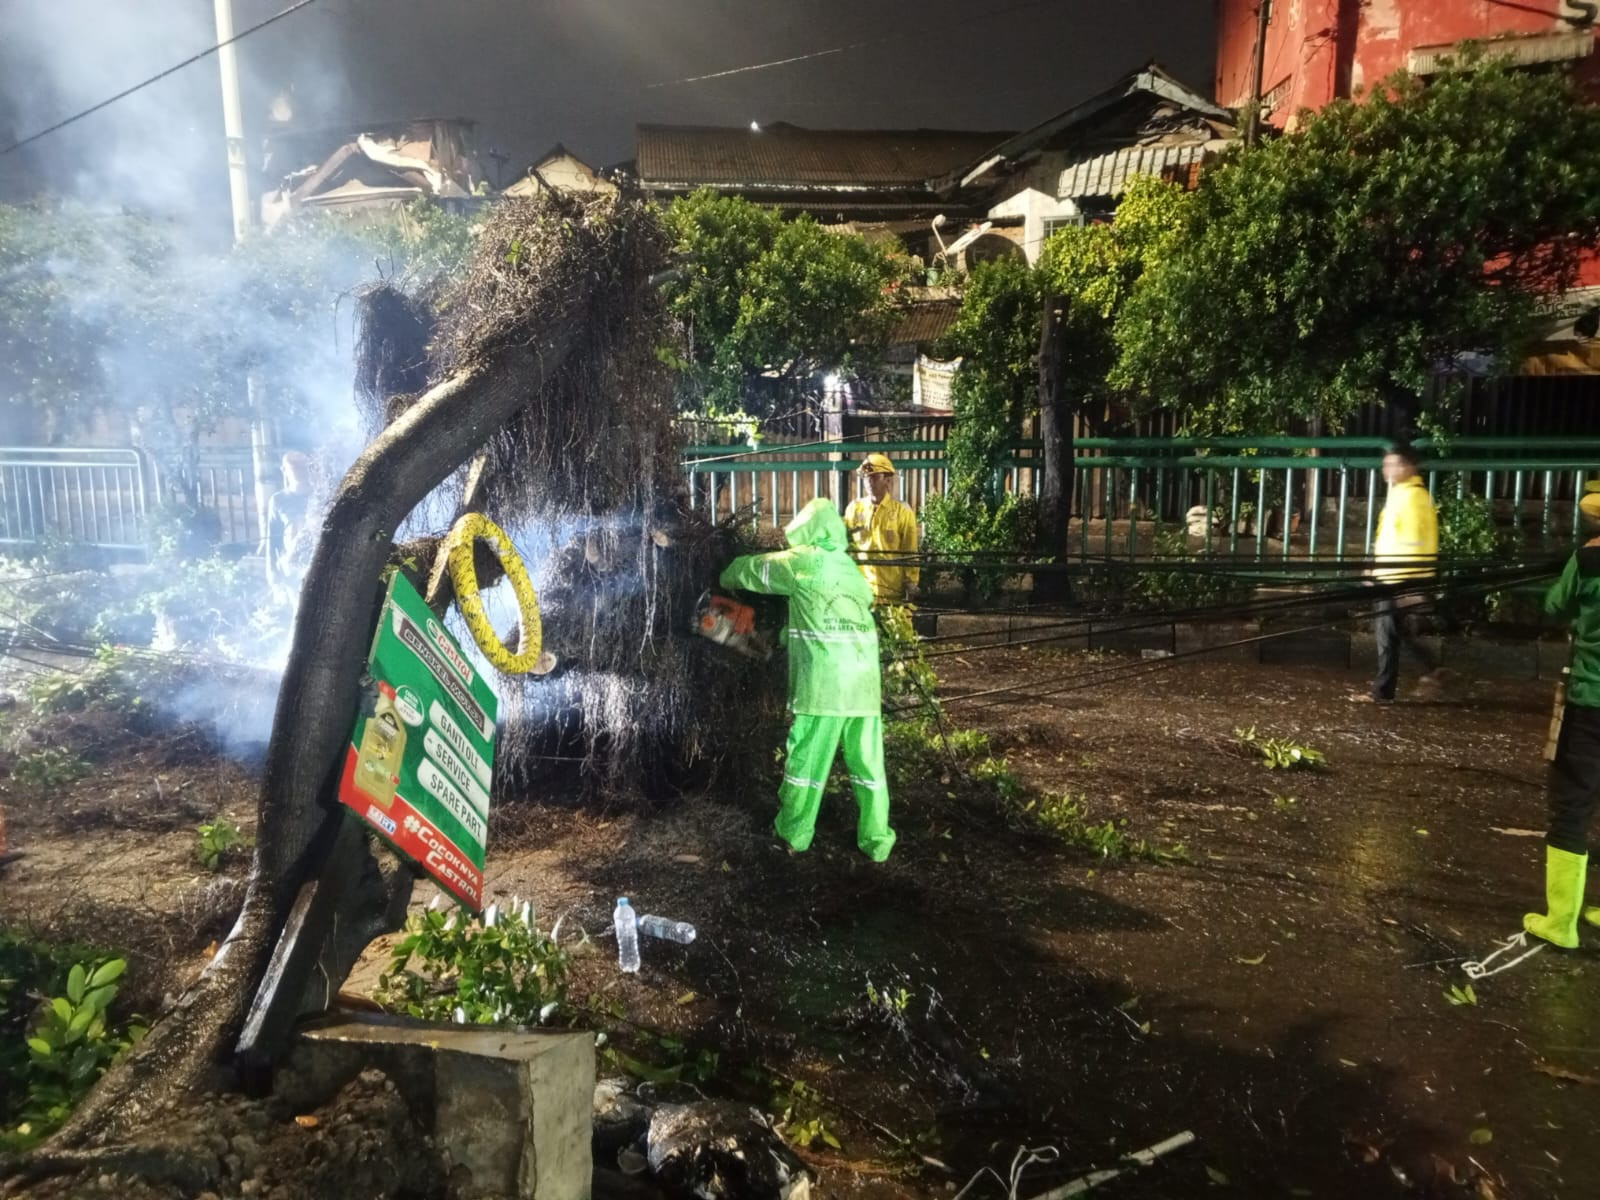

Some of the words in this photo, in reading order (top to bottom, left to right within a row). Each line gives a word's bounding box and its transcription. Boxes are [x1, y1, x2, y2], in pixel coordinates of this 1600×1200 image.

[404, 629, 450, 685] BENGKEL
[450, 682, 483, 730] MOTOR
[438, 635, 470, 681] Castrol
[436, 743, 471, 792] SERVICE
[441, 715, 465, 753] GANTI
[466, 746, 478, 769] OLI
[430, 774, 461, 813] SPARE
[460, 806, 482, 838] PART
[404, 815, 478, 885] #COCOKNYA
[426, 850, 478, 901] CASTROL
